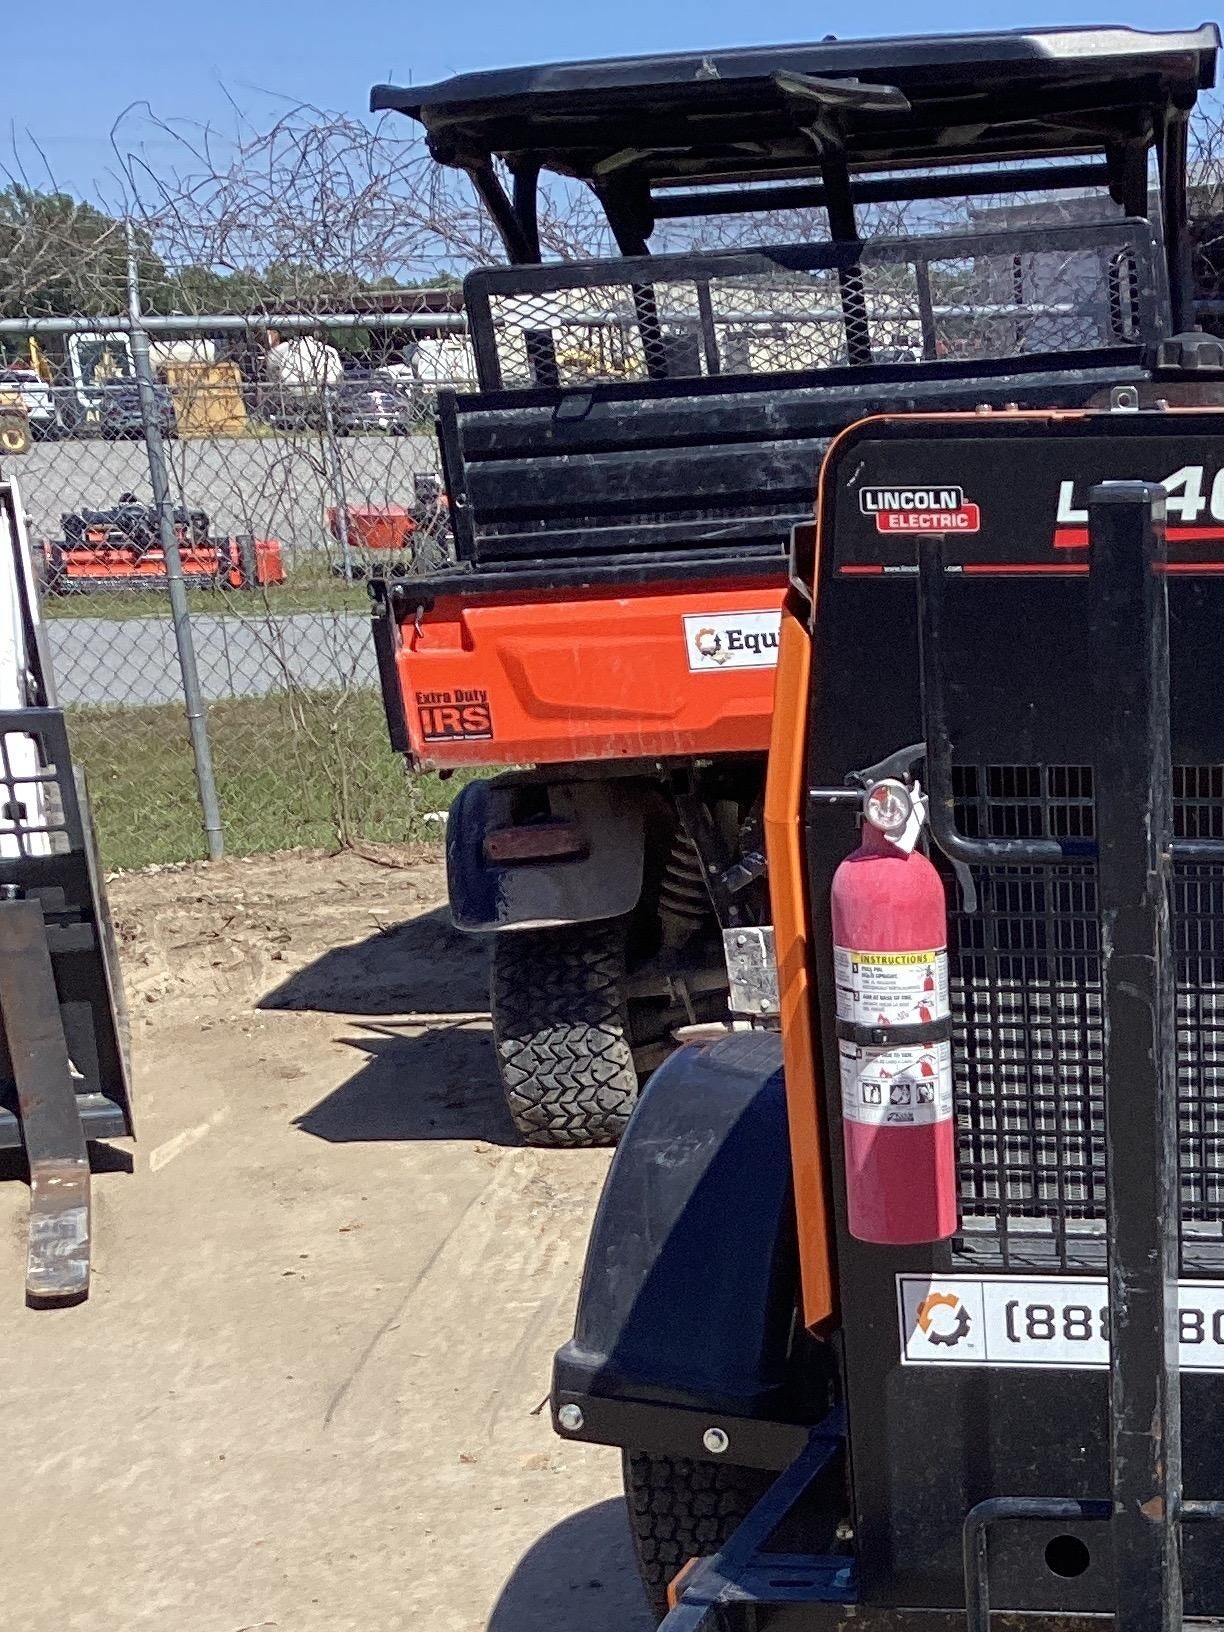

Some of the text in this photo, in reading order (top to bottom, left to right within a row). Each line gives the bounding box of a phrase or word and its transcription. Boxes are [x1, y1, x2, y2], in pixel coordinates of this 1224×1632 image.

[866, 491, 957, 510] LINCOLN
[888, 514, 969, 528] ELECTRIC
[726, 628, 781, 654] Equ
[416, 688, 487, 705] Extra Duty
[421, 706, 490, 733] IRS
[860, 954, 928, 965] INSTRUCTIONS
[1005, 1300, 1110, 1344] (88
